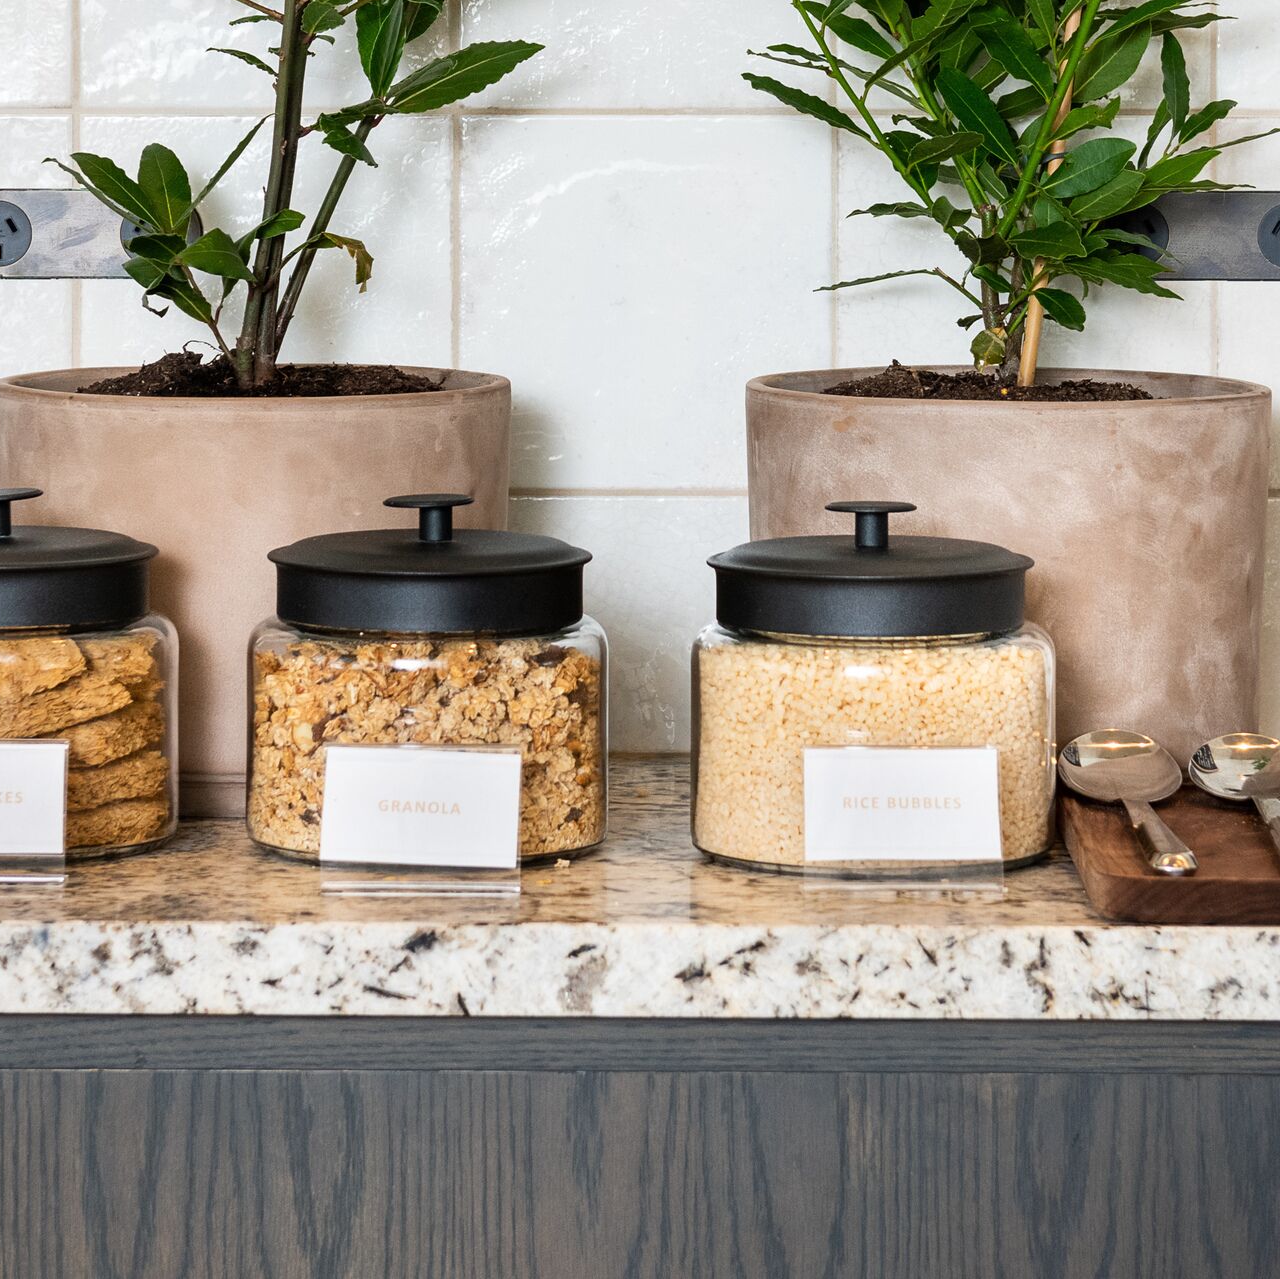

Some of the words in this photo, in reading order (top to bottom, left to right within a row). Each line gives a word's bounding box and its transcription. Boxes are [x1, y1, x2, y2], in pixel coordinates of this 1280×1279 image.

[377, 799, 462, 815] GRANOLA
[842, 796, 881, 810] RICE
[886, 796, 961, 810] BUBBLES
